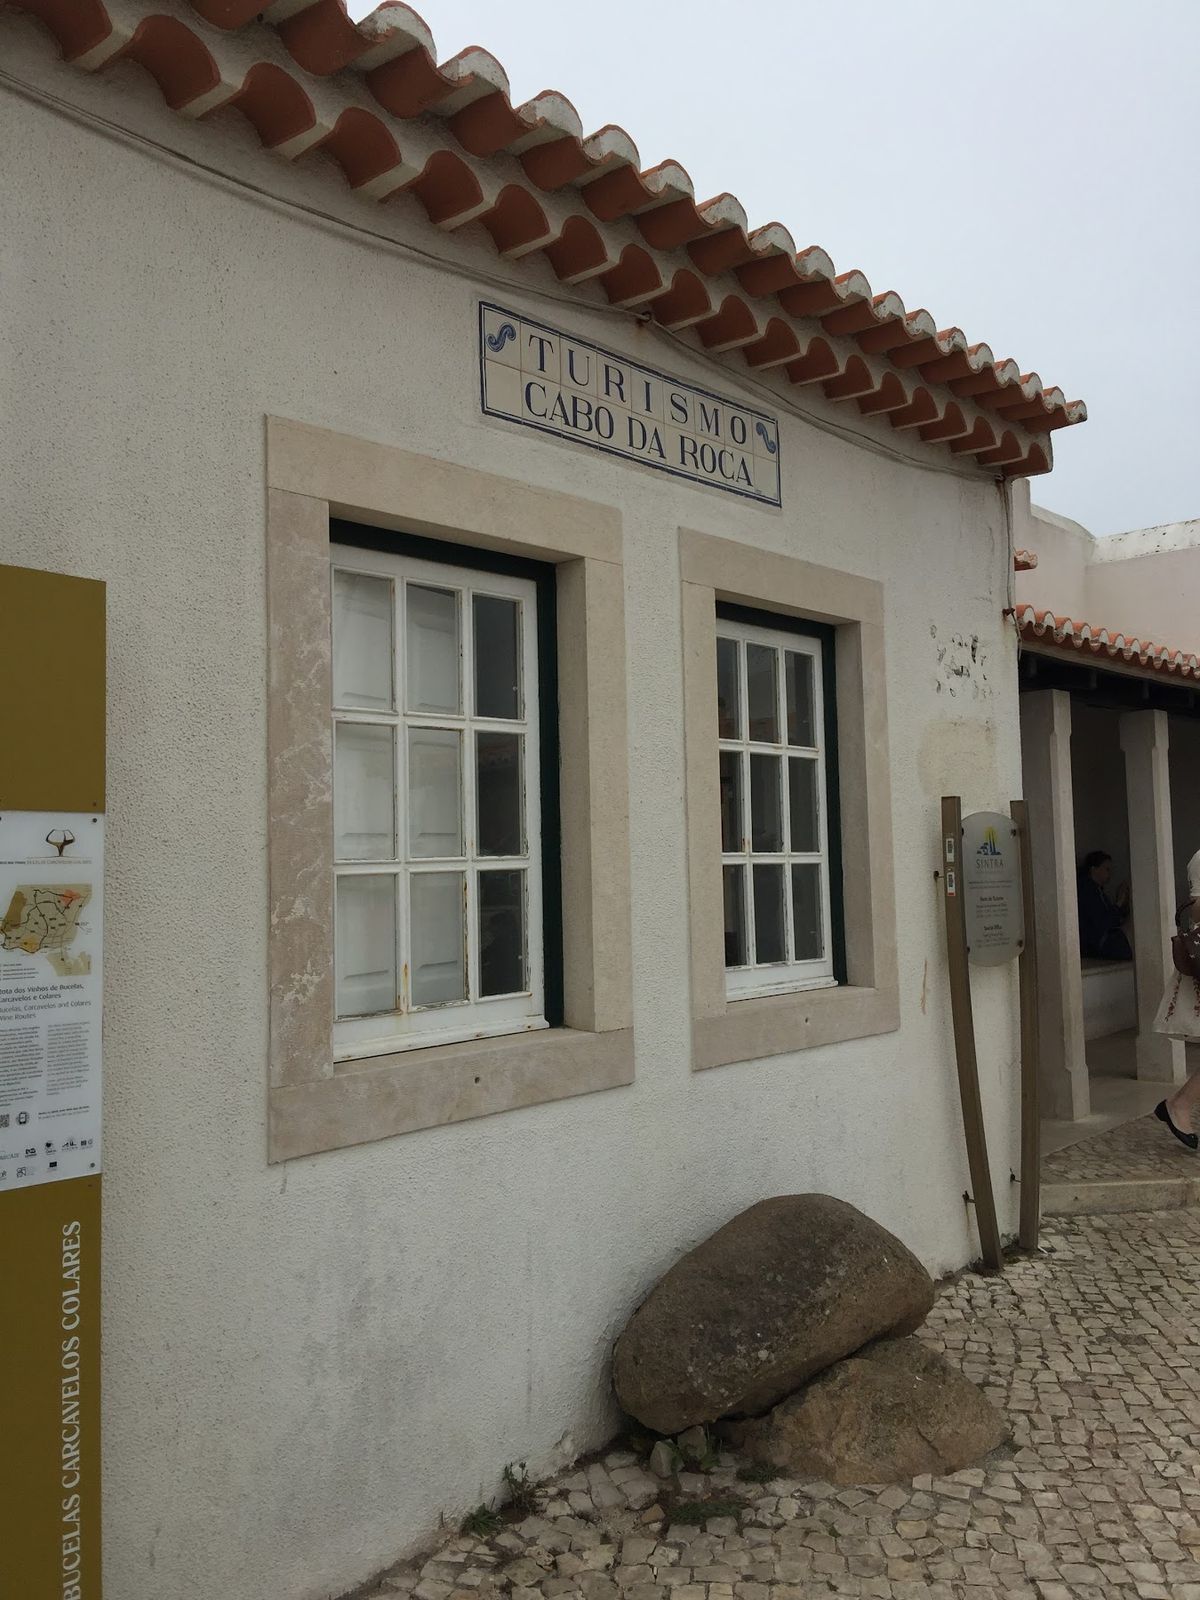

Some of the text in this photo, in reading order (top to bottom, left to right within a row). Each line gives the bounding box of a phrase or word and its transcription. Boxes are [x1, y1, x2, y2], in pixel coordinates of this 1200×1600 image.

[524, 381, 754, 487] CABO DA ROCA
[528, 334, 748, 445] TURISMO
[975, 858, 1004, 870] SINTRA
[27, 985, 49, 993] Vinhos
[61, 1220, 81, 1600] BUCELAS CARCAVELOS COLARES
